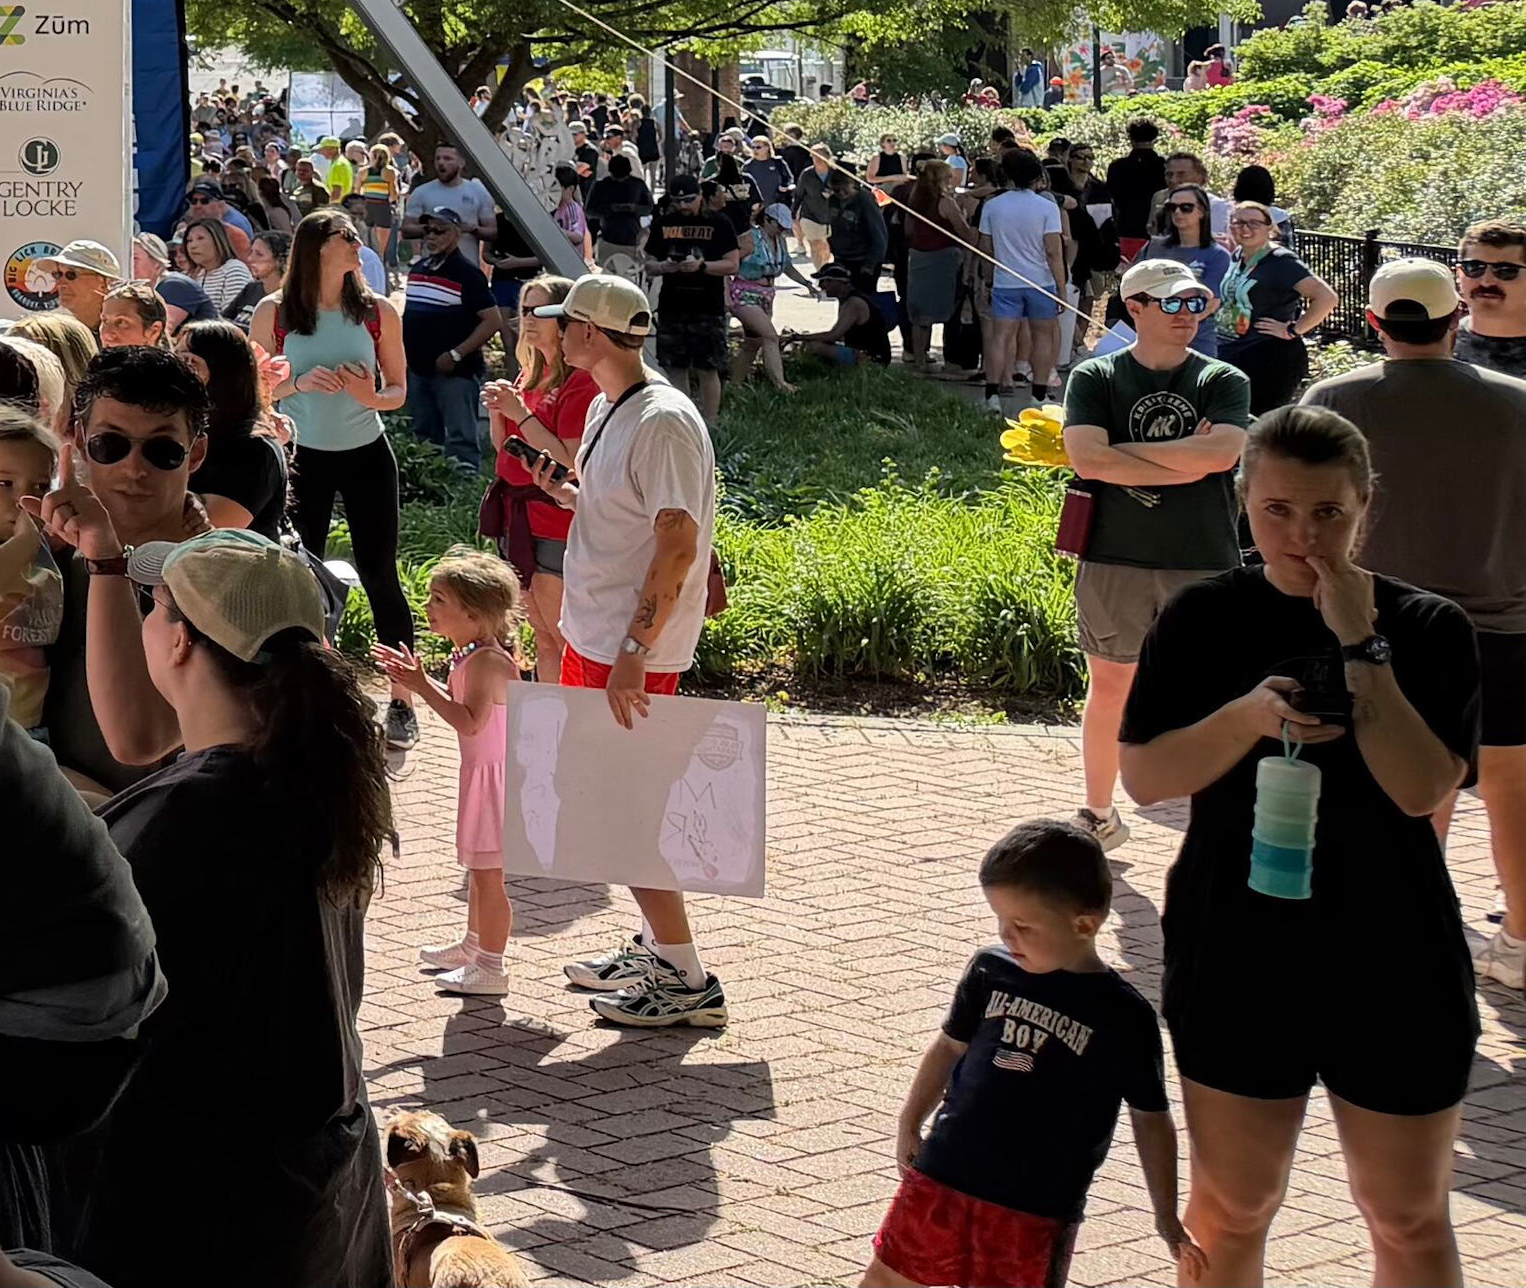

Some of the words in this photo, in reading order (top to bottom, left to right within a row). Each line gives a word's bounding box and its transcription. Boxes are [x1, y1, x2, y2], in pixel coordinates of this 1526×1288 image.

[0, 86, 78, 100] VIRGINIA'S
[0, 99, 32, 111] BLUE
[3, 199, 77, 217] LOCKE
[8, 266, 17, 283] BIG
[14, 246, 37, 262] LICK
[1000, 1017, 1049, 1054] BOY
